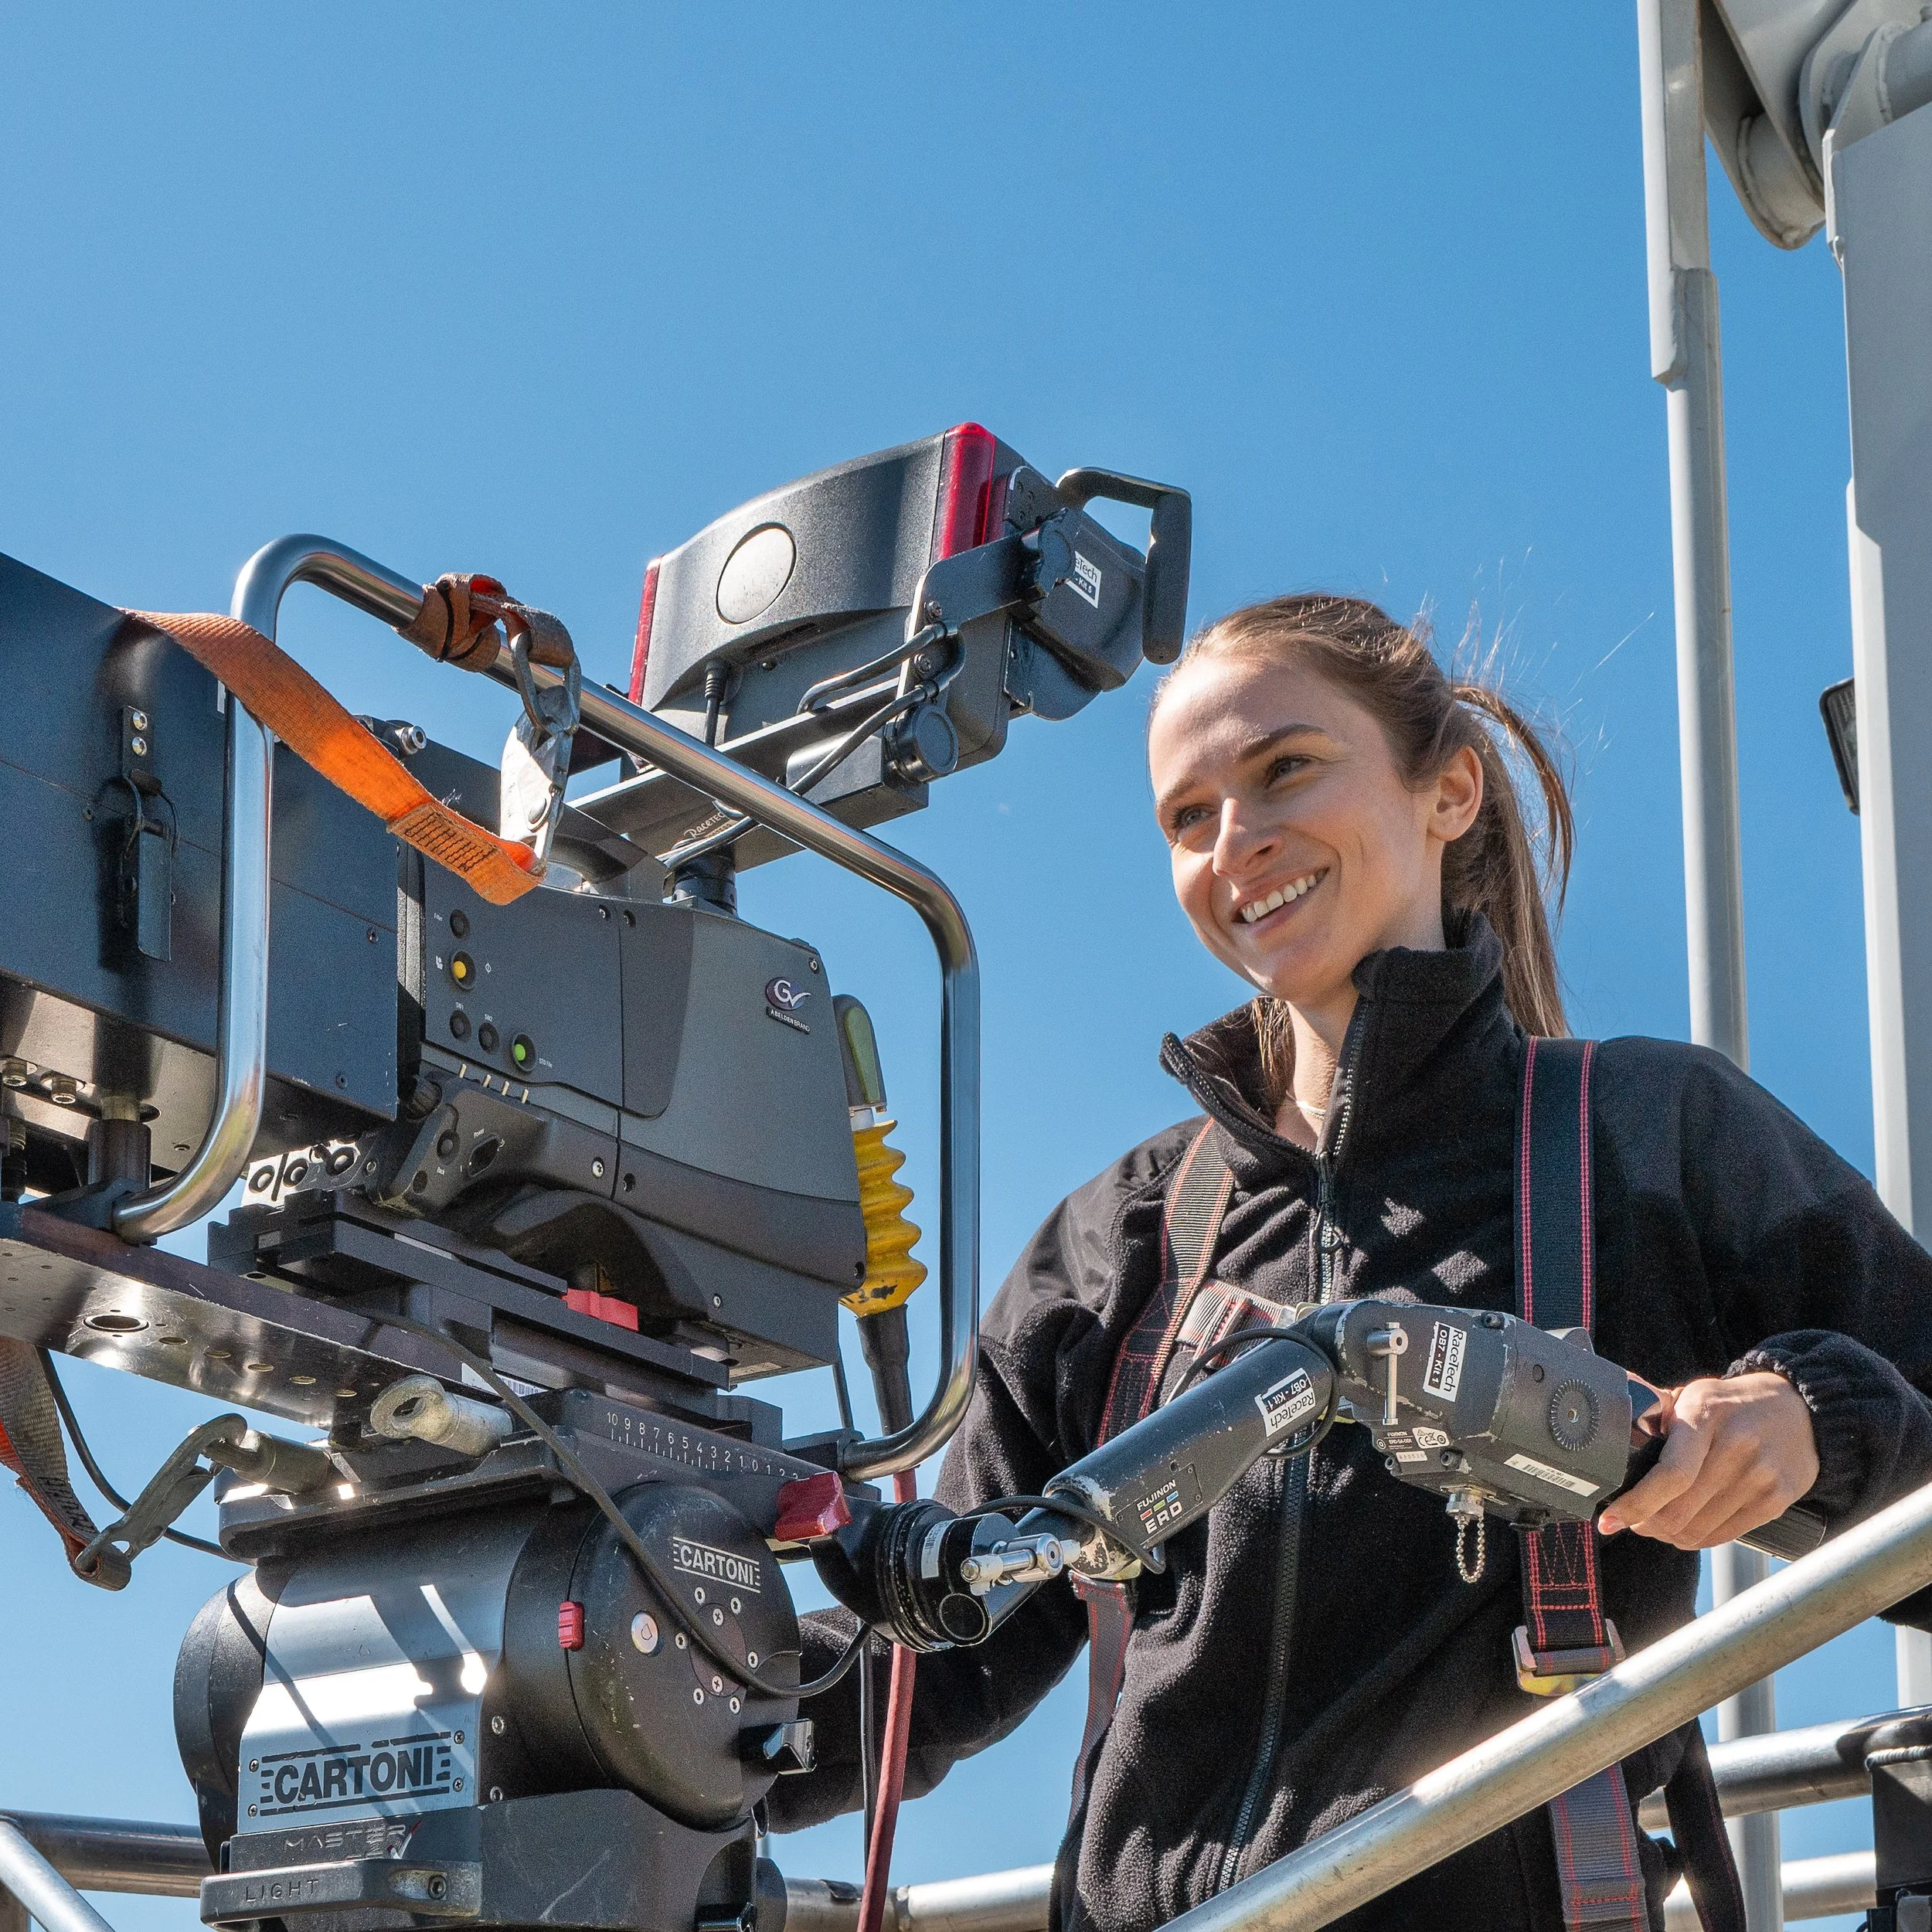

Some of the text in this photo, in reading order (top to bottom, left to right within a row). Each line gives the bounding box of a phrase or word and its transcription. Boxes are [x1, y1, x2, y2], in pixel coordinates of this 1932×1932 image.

[774, 1010, 794, 1025] BELDEN
[794, 1019, 811, 1032] BRAND
[1437, 1329, 1447, 1352] OB7
[1433, 1359, 1443, 1375] Kit
[1443, 1329, 1464, 1393] RaceTech
[1267, 1400, 1274, 1410] 1
[1270, 1392, 1315, 1428] RaceTech
[1272, 1391, 1286, 1405] Kit
[607, 1412, 617, 1426] 10
[624, 1417, 631, 1430] 9
[639, 1422, 645, 1435] 8
[654, 1427, 660, 1439] 7
[668, 1432, 675, 1444] 6
[682, 1437, 689, 1449] 5
[696, 1441, 702, 1454] 4
[710, 1446, 716, 1458] 3
[724, 1451, 730, 1463] 2
[739, 1455, 743, 1467] 1
[752, 1459, 758, 1471] 0
[766, 1464, 770, 1475] 1
[1136, 1479, 1176, 1512] FUJINON
[1145, 1501, 1182, 1534] ERD
[681, 1545, 753, 1586] CARTONI
[274, 1746, 434, 1804] CARTONI
[284, 1824, 406, 1853] MASTER
[245, 1879, 319, 1903] LIGHT
